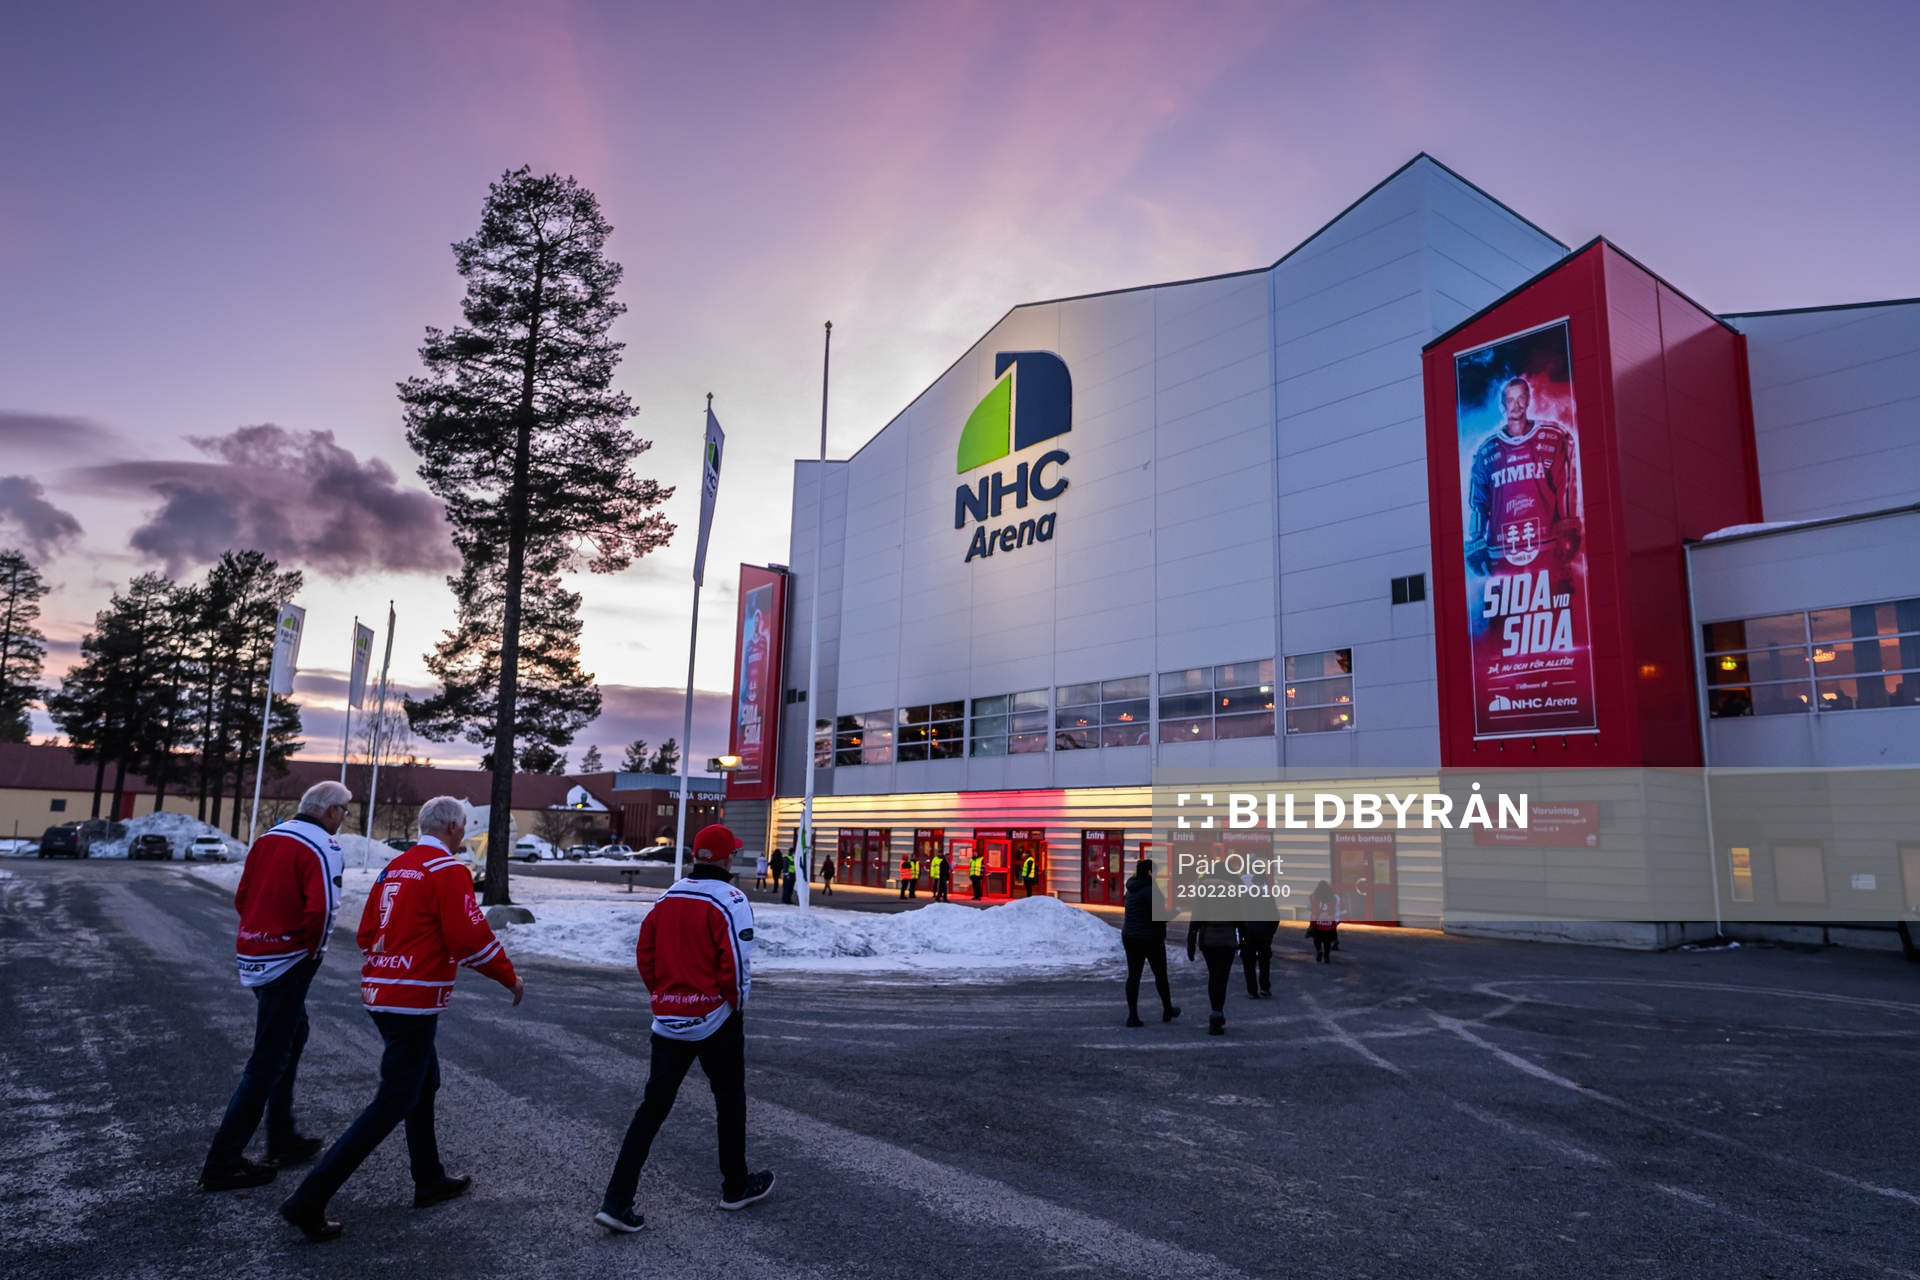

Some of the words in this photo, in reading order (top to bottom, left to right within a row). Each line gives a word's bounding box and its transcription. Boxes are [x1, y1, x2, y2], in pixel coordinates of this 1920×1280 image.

[955, 448, 1070, 530] NHC
[965, 512, 1057, 563] Arena
[1483, 570, 1551, 618] SIDA
[1553, 594, 1570, 608] VID
[1502, 609, 1574, 657] SIDA
[1513, 663, 1528, 671] OCH
[1512, 698, 1542, 709] NHC
[1545, 697, 1577, 707] Arena
[1086, 830, 1105, 839] Entré
[1173, 831, 1194, 841] Entré
[1335, 834, 1356, 843] Entré
